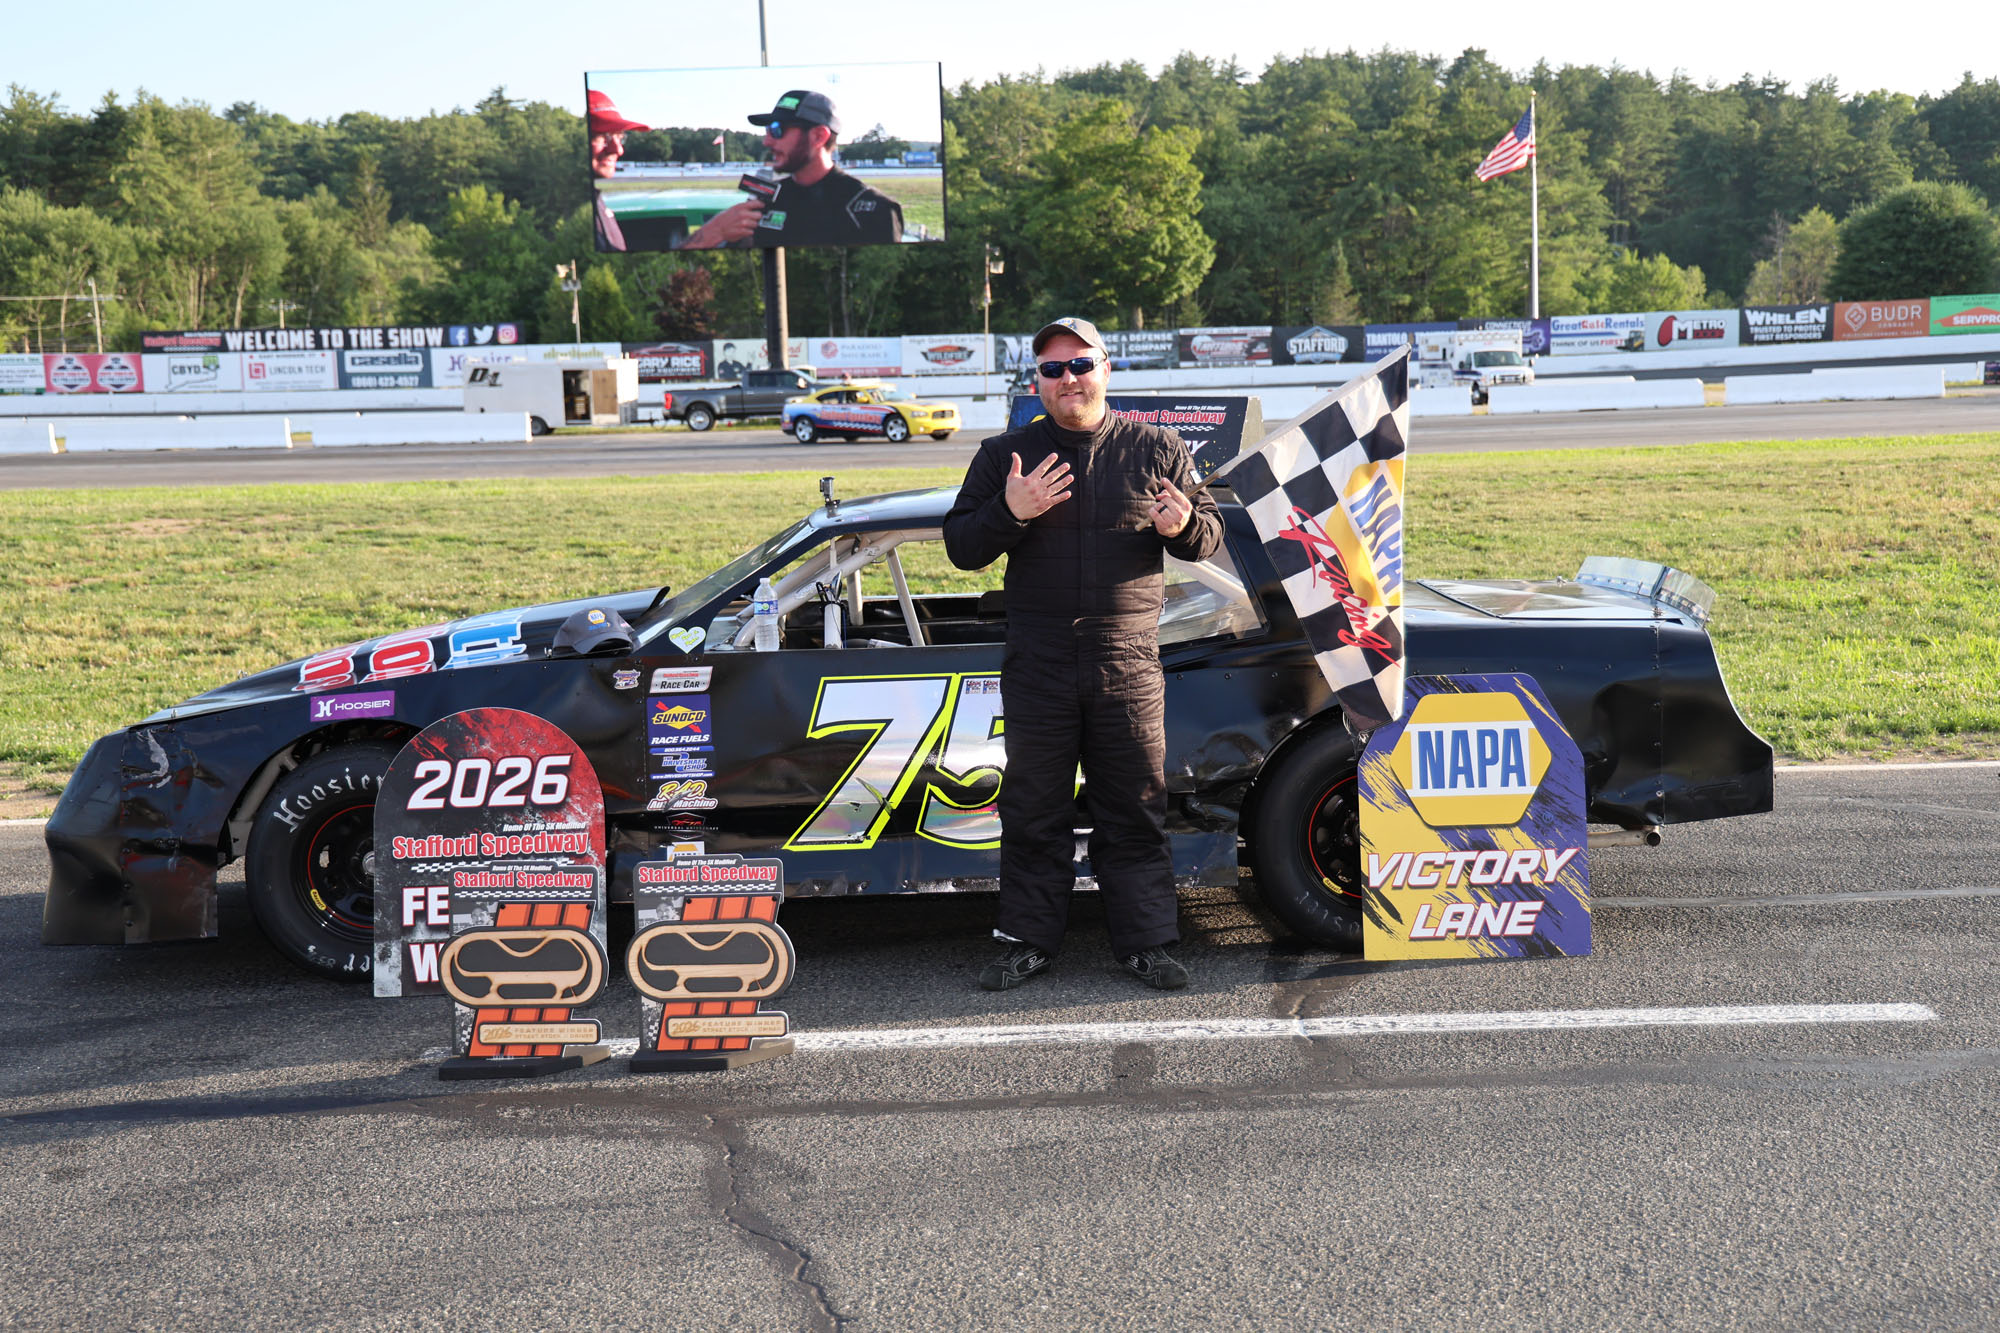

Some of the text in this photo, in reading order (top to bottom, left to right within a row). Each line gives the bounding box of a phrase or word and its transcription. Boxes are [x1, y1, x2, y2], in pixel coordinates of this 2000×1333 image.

[1744, 306, 1828, 326] WHELEN
[1871, 305, 1922, 322] BUDR
[1672, 320, 1726, 340] METRO
[1750, 326, 1782, 334] TRUSTED
[1794, 324, 1826, 332] PROTECT
[1754, 332, 1822, 341] FIRST RESPONDERS
[225, 327, 444, 351] WELCOME TO THE SHOW
[1129, 333, 1172, 342] DEFENSE
[1366, 332, 1408, 347] TRANTOLO
[1129, 342, 1172, 352] COMPANY
[1290, 337, 1346, 354] STAFFORD
[670, 356, 701, 368] RICE
[172, 365, 200, 376] CBYD
[269, 364, 326, 376] LINCOLN TECH
[1160, 410, 1226, 425] Speedway
[1350, 474, 1402, 594] NAPA
[1279, 506, 1401, 668] Racing
[660, 680, 700, 689] RACE CAR
[335, 699, 391, 712] HOOSIER
[654, 712, 704, 724] SUNOCO
[651, 734, 710, 745] RACE FUELS
[1417, 728, 1527, 790] NAPA
[406, 754, 574, 811] 2026
[673, 799, 715, 808] Machine
[502, 822, 586, 832] Home Of The SK Modified
[392, 832, 588, 859] Stafford Speedway
[639, 864, 777, 883] Stafford Speedway
[1367, 848, 1581, 890] VICTORY
[454, 872, 593, 888] Stafford Speedway
[1408, 900, 1545, 940] LANE
[483, 1026, 512, 1040] 2026
[672, 1020, 700, 1035] 2026
